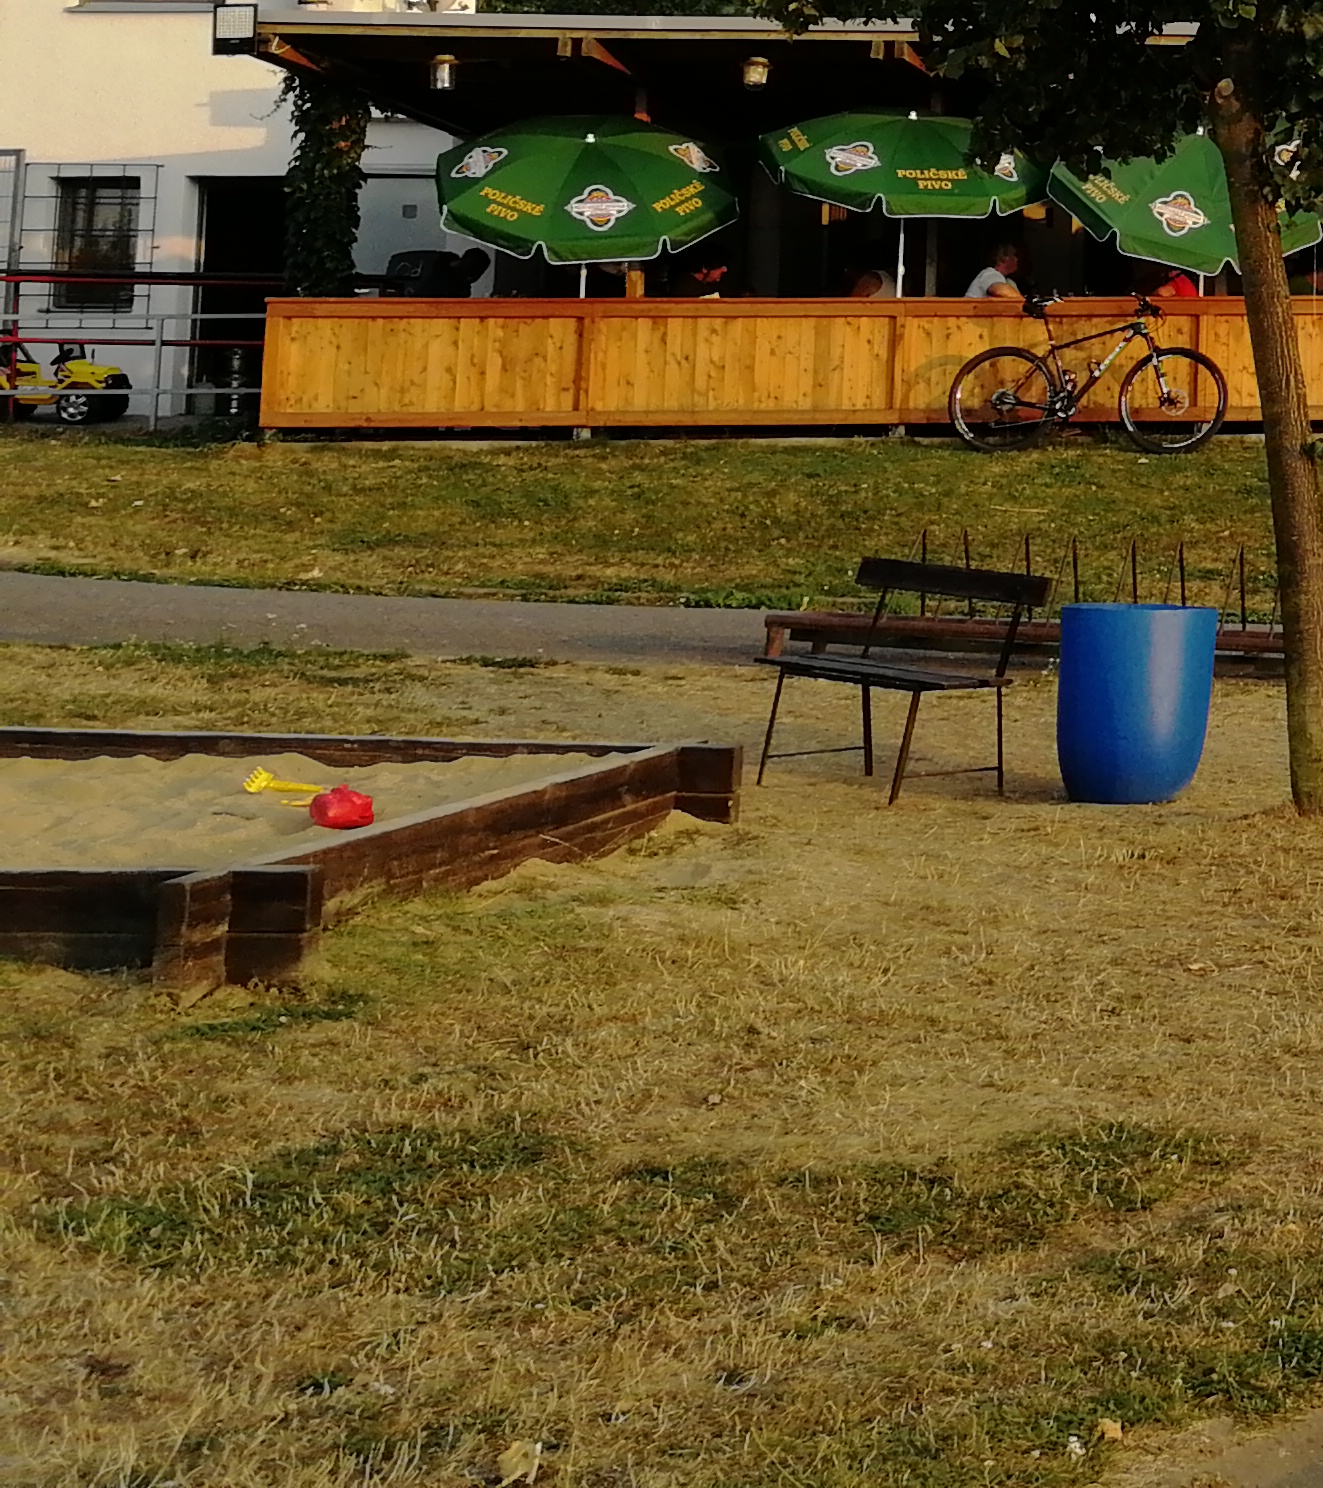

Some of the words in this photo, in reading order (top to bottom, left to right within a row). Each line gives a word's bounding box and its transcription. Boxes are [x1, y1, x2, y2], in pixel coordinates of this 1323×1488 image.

[896, 168, 968, 180] POLIČSKÉ
[918, 180, 952, 190] PIVO
[1081, 183, 1106, 203] PIVO
[479, 186, 545, 216] POLIČSKÉ
[652, 180, 705, 212] POLIČSKÉ
[486, 203, 519, 222] PIVO
[675, 198, 703, 216] PIVO
